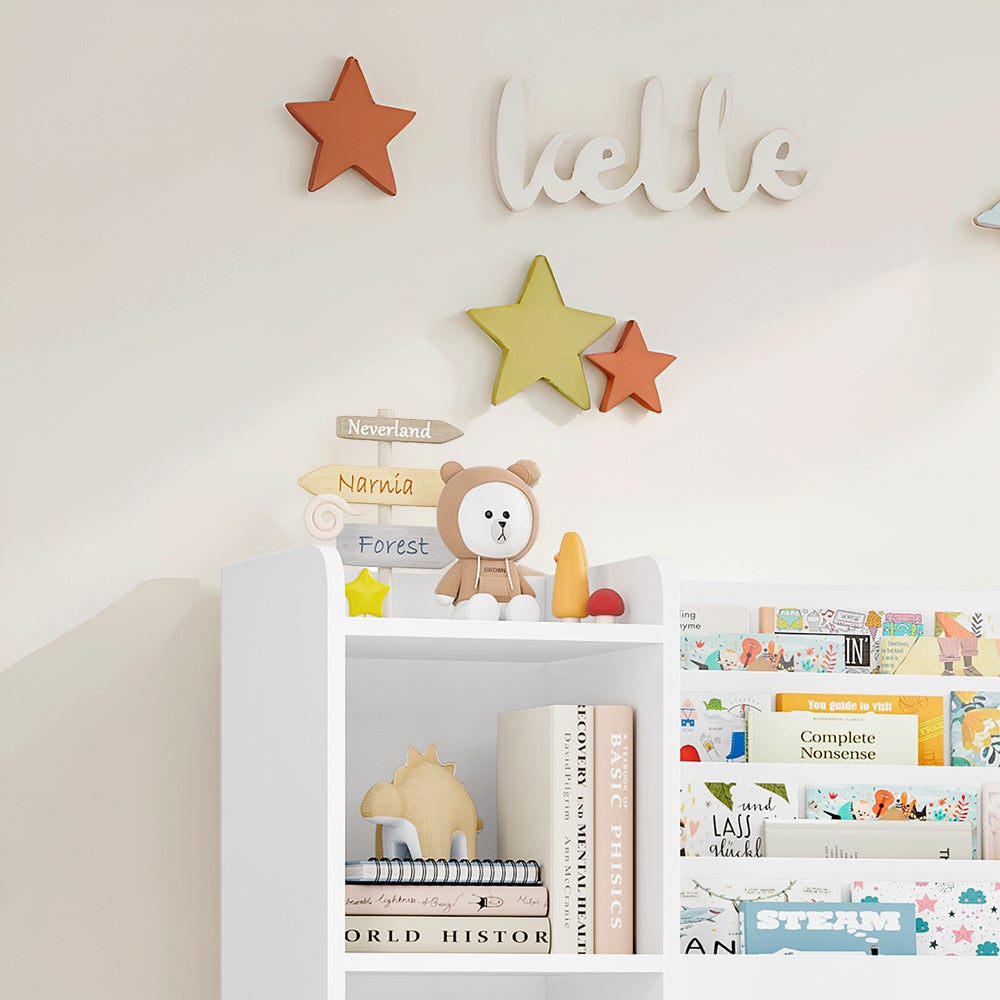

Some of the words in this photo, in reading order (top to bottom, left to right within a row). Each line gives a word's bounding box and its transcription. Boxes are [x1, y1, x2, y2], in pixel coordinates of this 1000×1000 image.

[347, 419, 432, 440] Neverland
[338, 473, 414, 496] Narnia
[358, 536, 430, 556] Forest
[680, 609, 696, 620] ing
[808, 700, 826, 710] You
[829, 700, 857, 711] guide
[860, 701, 869, 711] to
[873, 702, 892, 712] visit
[800, 730, 876, 746] Complete
[800, 747, 876, 760] Nonsense
[610, 733, 622, 808] BASIC
[738, 797, 776, 811] und
[713, 814, 751, 838] LASS
[577, 824, 587, 892] MENTAL
[610, 825, 622, 929] PHISICS
[756, 910, 901, 931] STEAM
